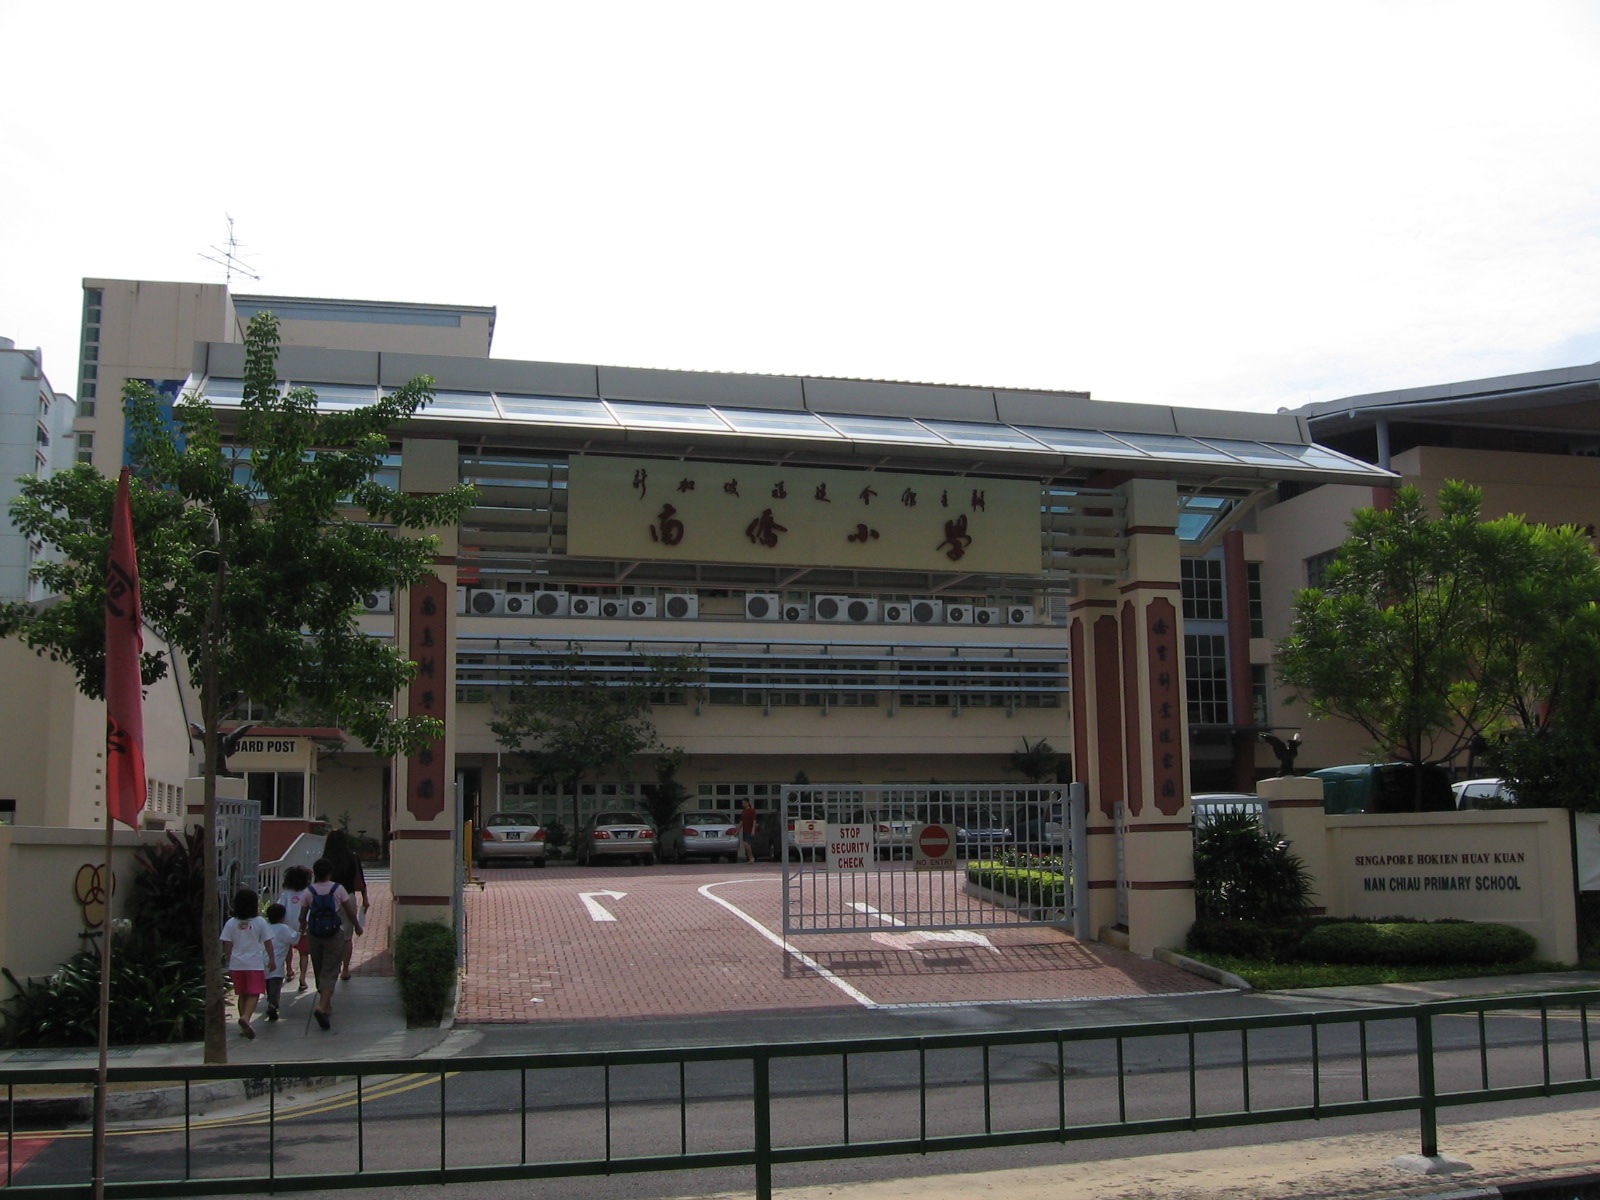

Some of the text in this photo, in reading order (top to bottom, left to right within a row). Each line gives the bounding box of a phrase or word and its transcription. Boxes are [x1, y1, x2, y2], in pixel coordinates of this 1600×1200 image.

[649, 503, 972, 561] 南僑小學
[235, 740, 296, 753] UARD POST
[217, 828, 223, 842] A
[840, 827, 861, 839] STOP
[831, 842, 870, 854] SECURITY
[838, 857, 865, 869] CHECK
[930, 858, 954, 866] ENTRY
[1355, 852, 1525, 866] SINGAPORE HOKIEN HUAY KUAN
[1364, 876, 1522, 891] NAN CHIAU PRIMARY SCHOOL
